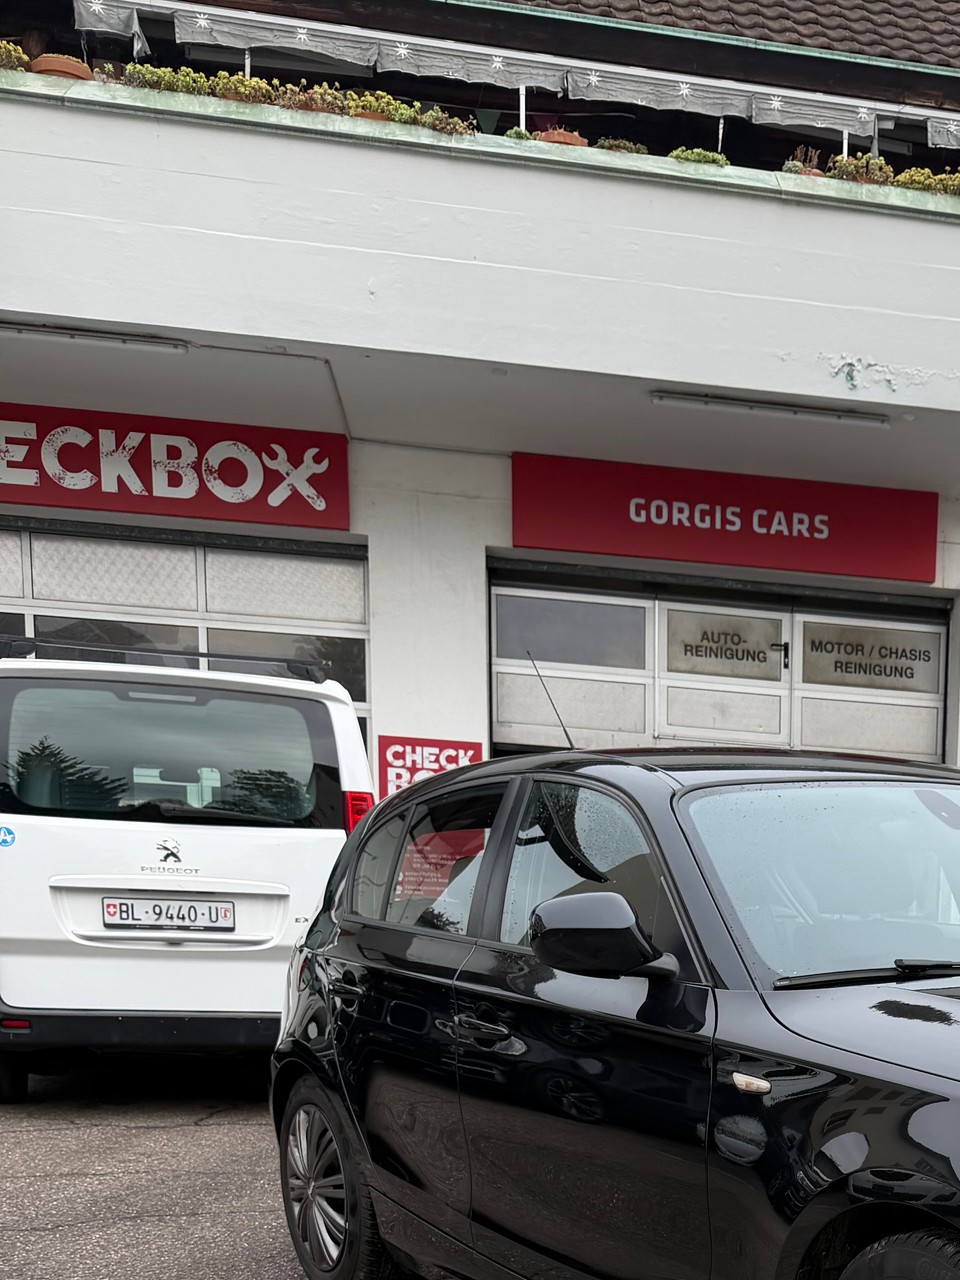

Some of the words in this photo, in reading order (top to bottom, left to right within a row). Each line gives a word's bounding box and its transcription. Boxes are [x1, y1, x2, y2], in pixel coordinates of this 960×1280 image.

[629, 497, 742, 531] GORGIS
[752, 508, 830, 539] CARS
[700, 630, 748, 647] AUTO-
[683, 643, 768, 663] REINIGUNG
[810, 639, 865, 657] MOTOR
[868, 645, 875, 657] /
[878, 646, 932, 663] CHASIS
[834, 660, 915, 679] REINIGUNG
[386, 744, 475, 770] CHECK
[140, 866, 201, 875] PEUGEOT
